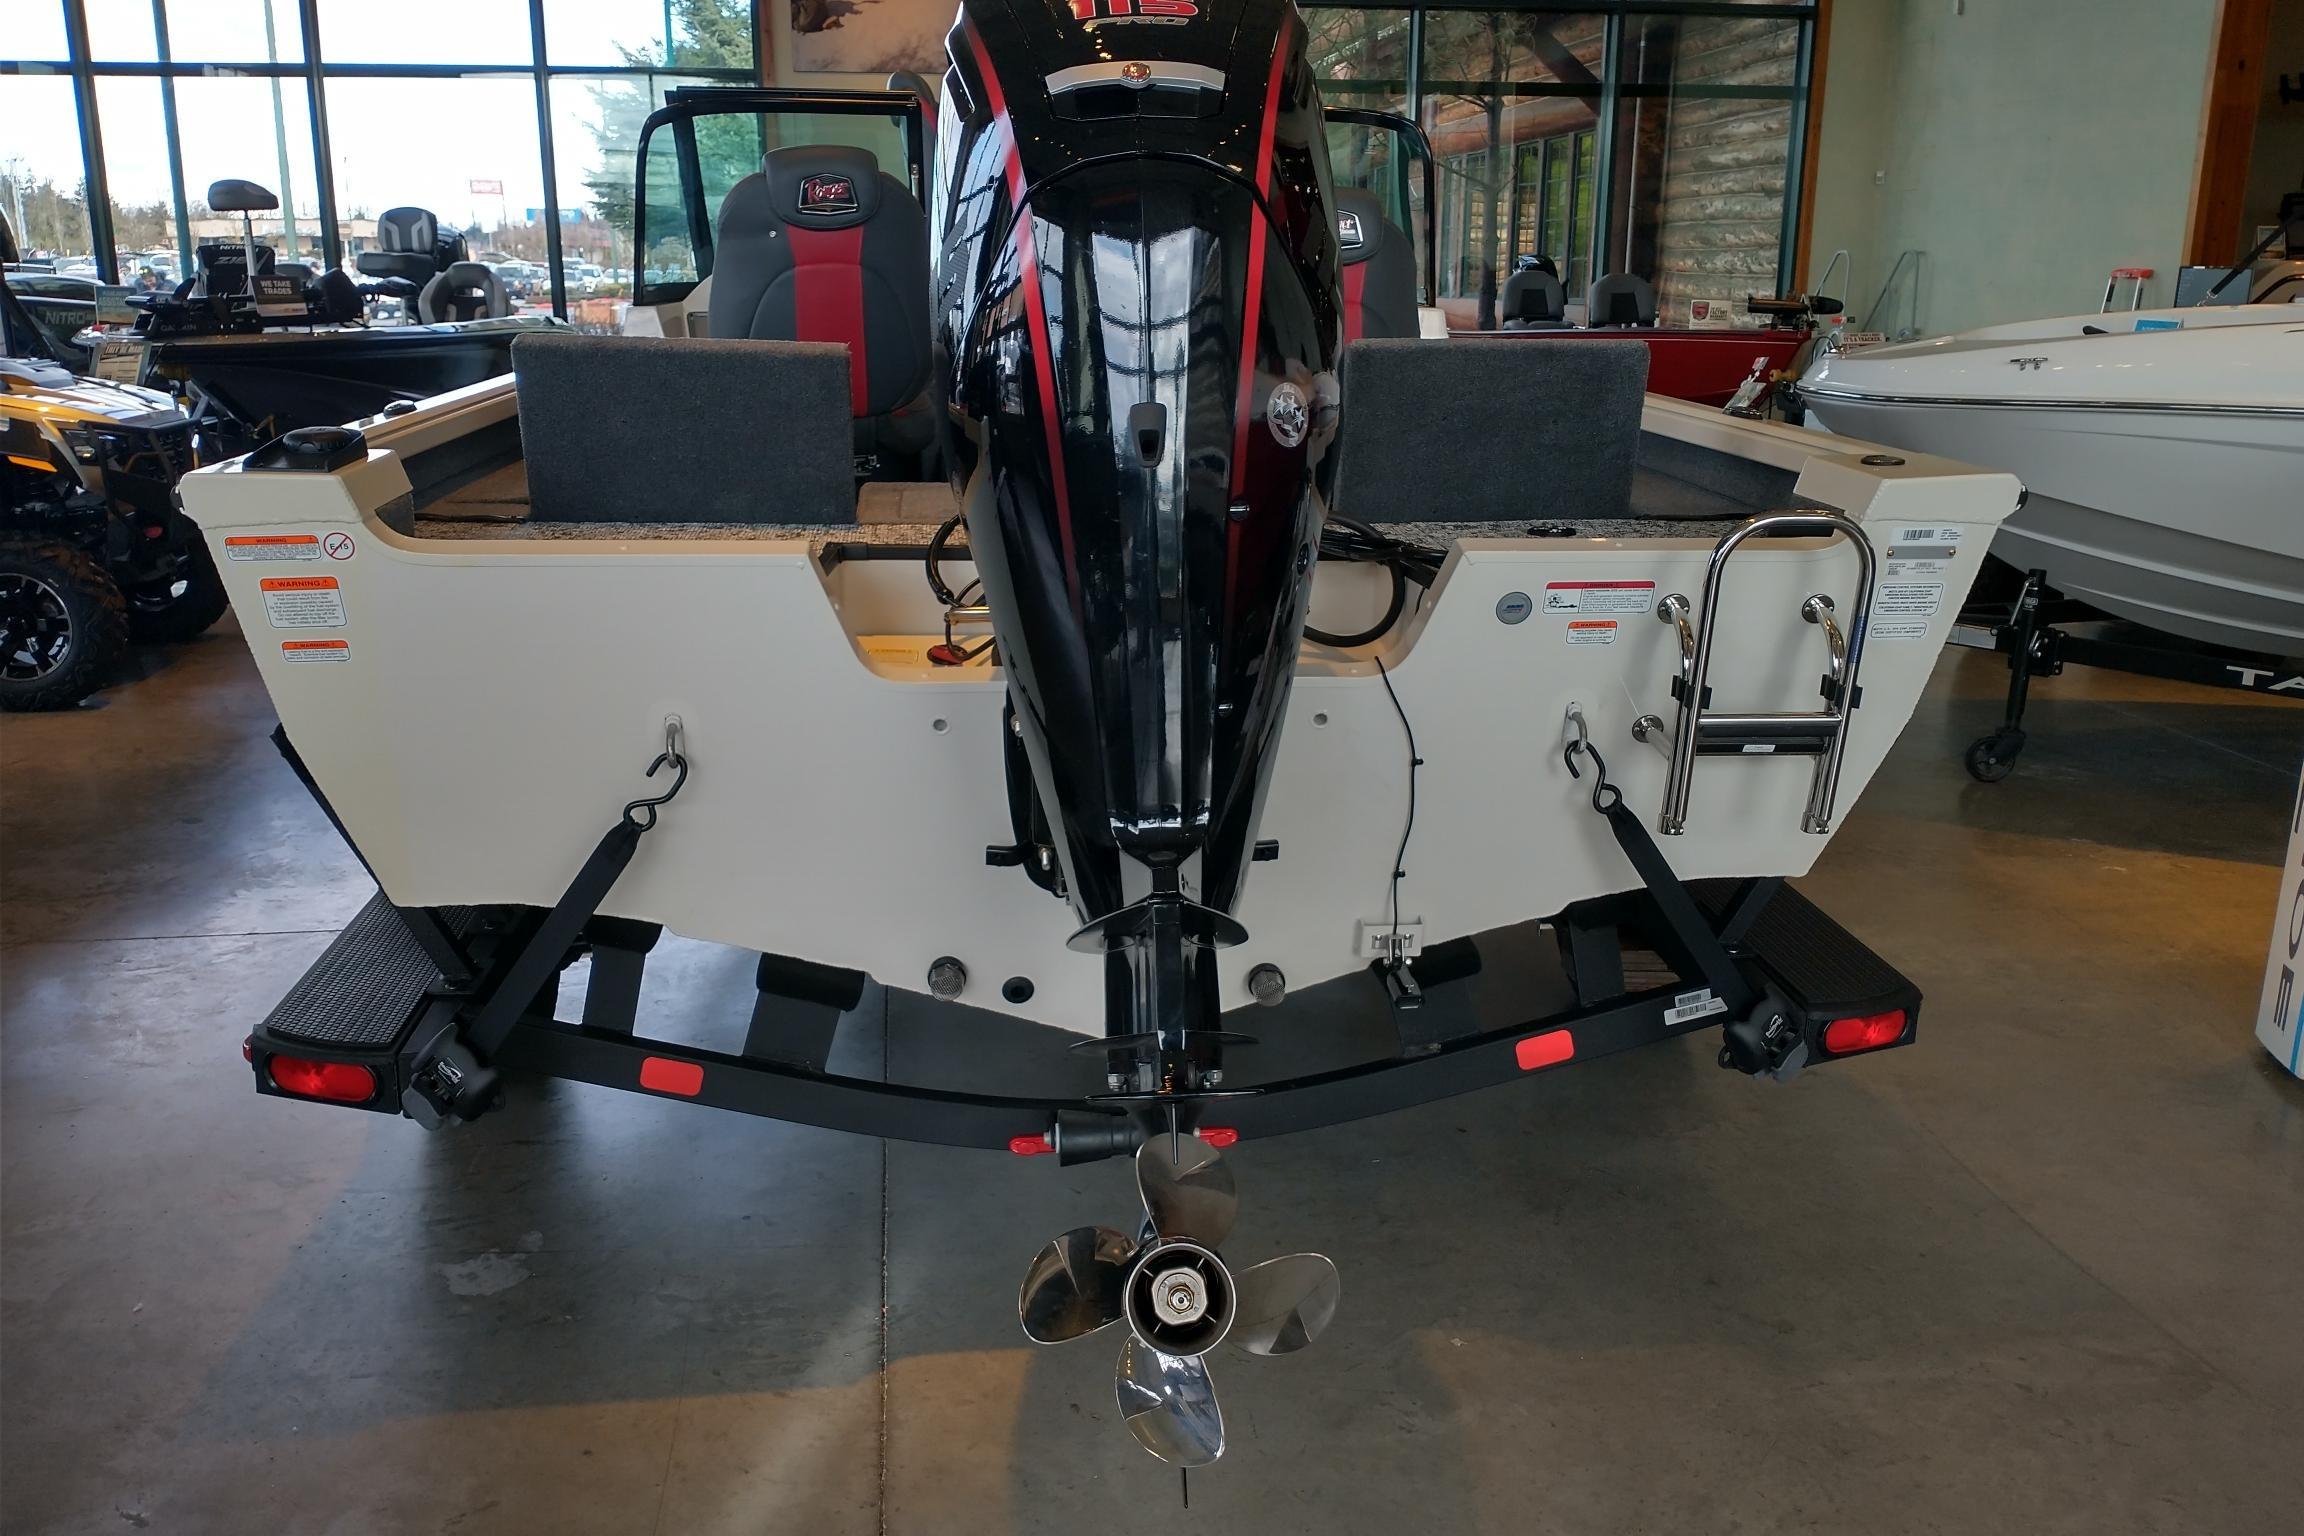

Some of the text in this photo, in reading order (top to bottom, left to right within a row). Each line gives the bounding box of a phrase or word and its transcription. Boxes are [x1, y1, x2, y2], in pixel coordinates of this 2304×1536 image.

[1082, 15, 1190, 31] PRO
[260, 280, 292, 288] WE TAKE
[263, 287, 292, 295] TRADES
[45, 311, 85, 325] NITRO
[277, 580, 320, 588] WARNING
